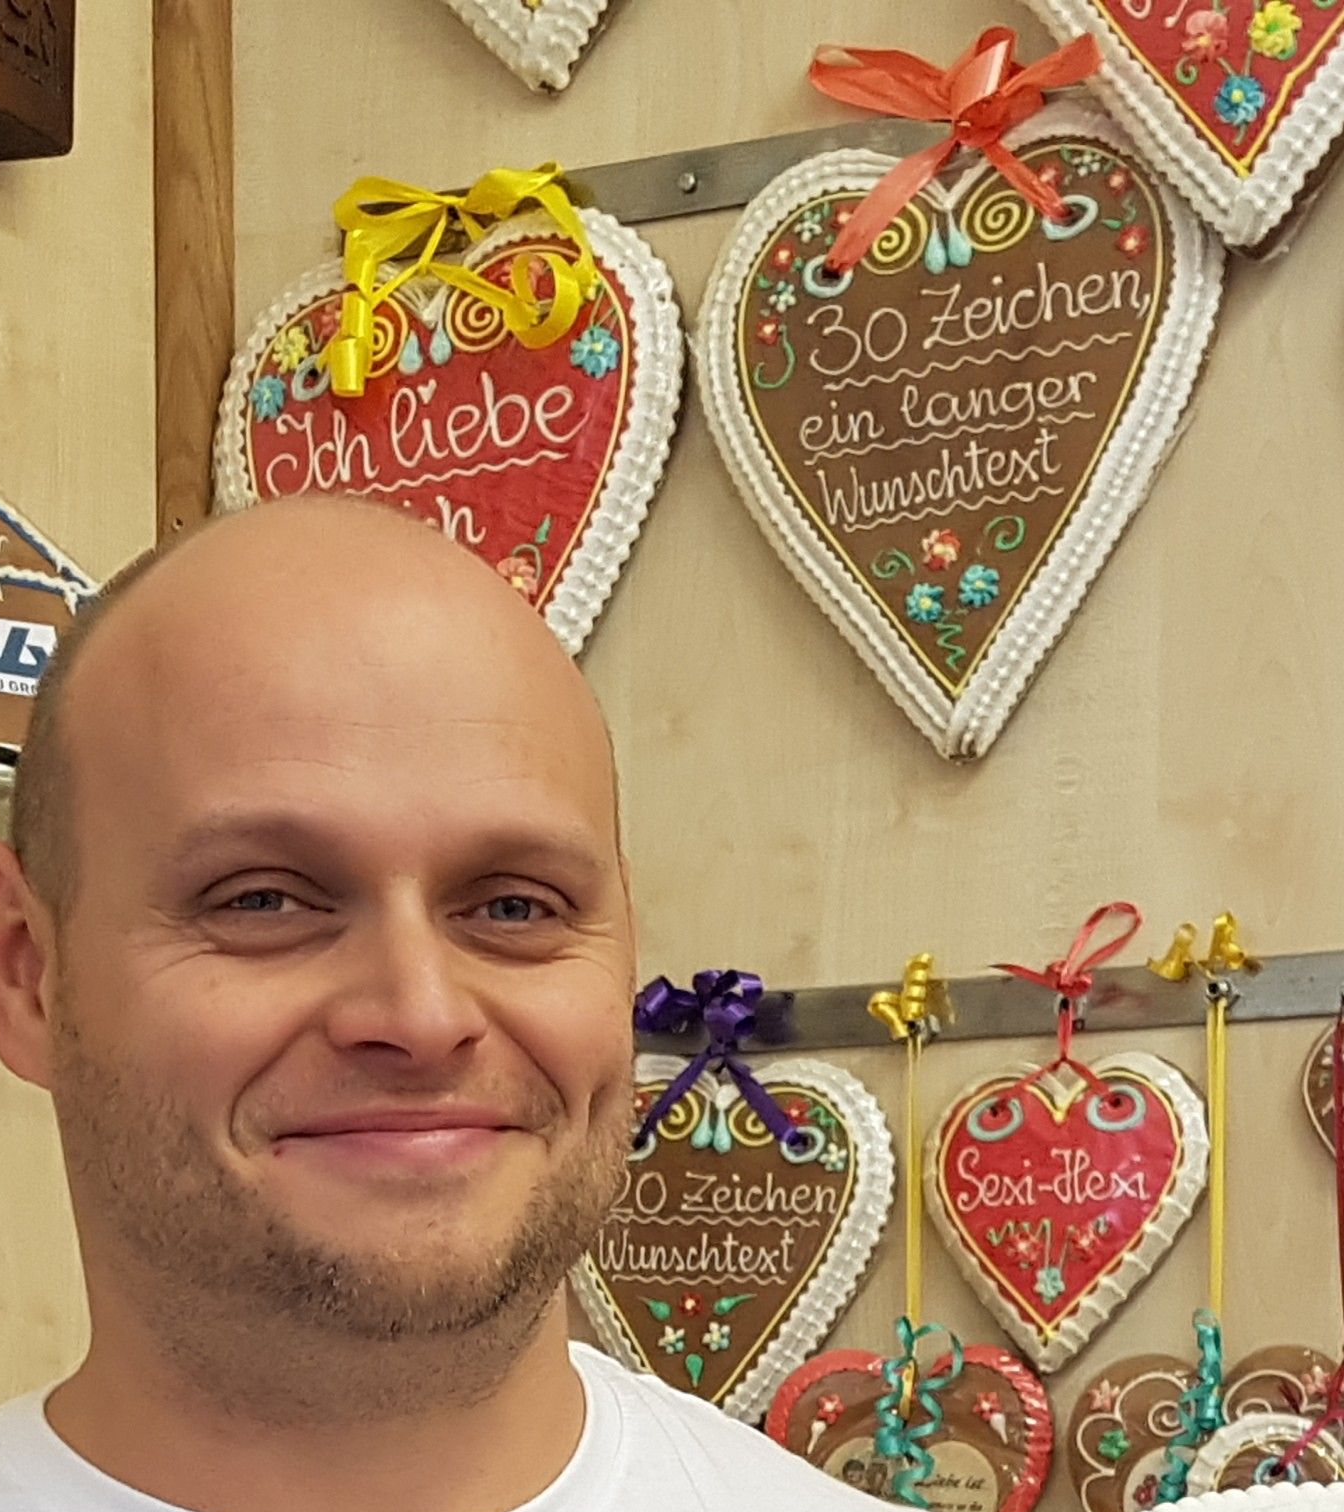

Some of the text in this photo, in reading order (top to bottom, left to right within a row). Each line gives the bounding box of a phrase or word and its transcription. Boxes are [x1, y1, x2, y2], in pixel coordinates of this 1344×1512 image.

[807, 262, 1152, 375] 30 Zeichen,
[389, 371, 588, 469] liebe
[799, 369, 1098, 452] ein langer
[816, 428, 1062, 526] Wunschtext
[681, 1170, 837, 1215] Zeichen
[956, 1147, 1151, 1213] Sexi-Hexi
[598, 1228, 795, 1274] Wunschtext
